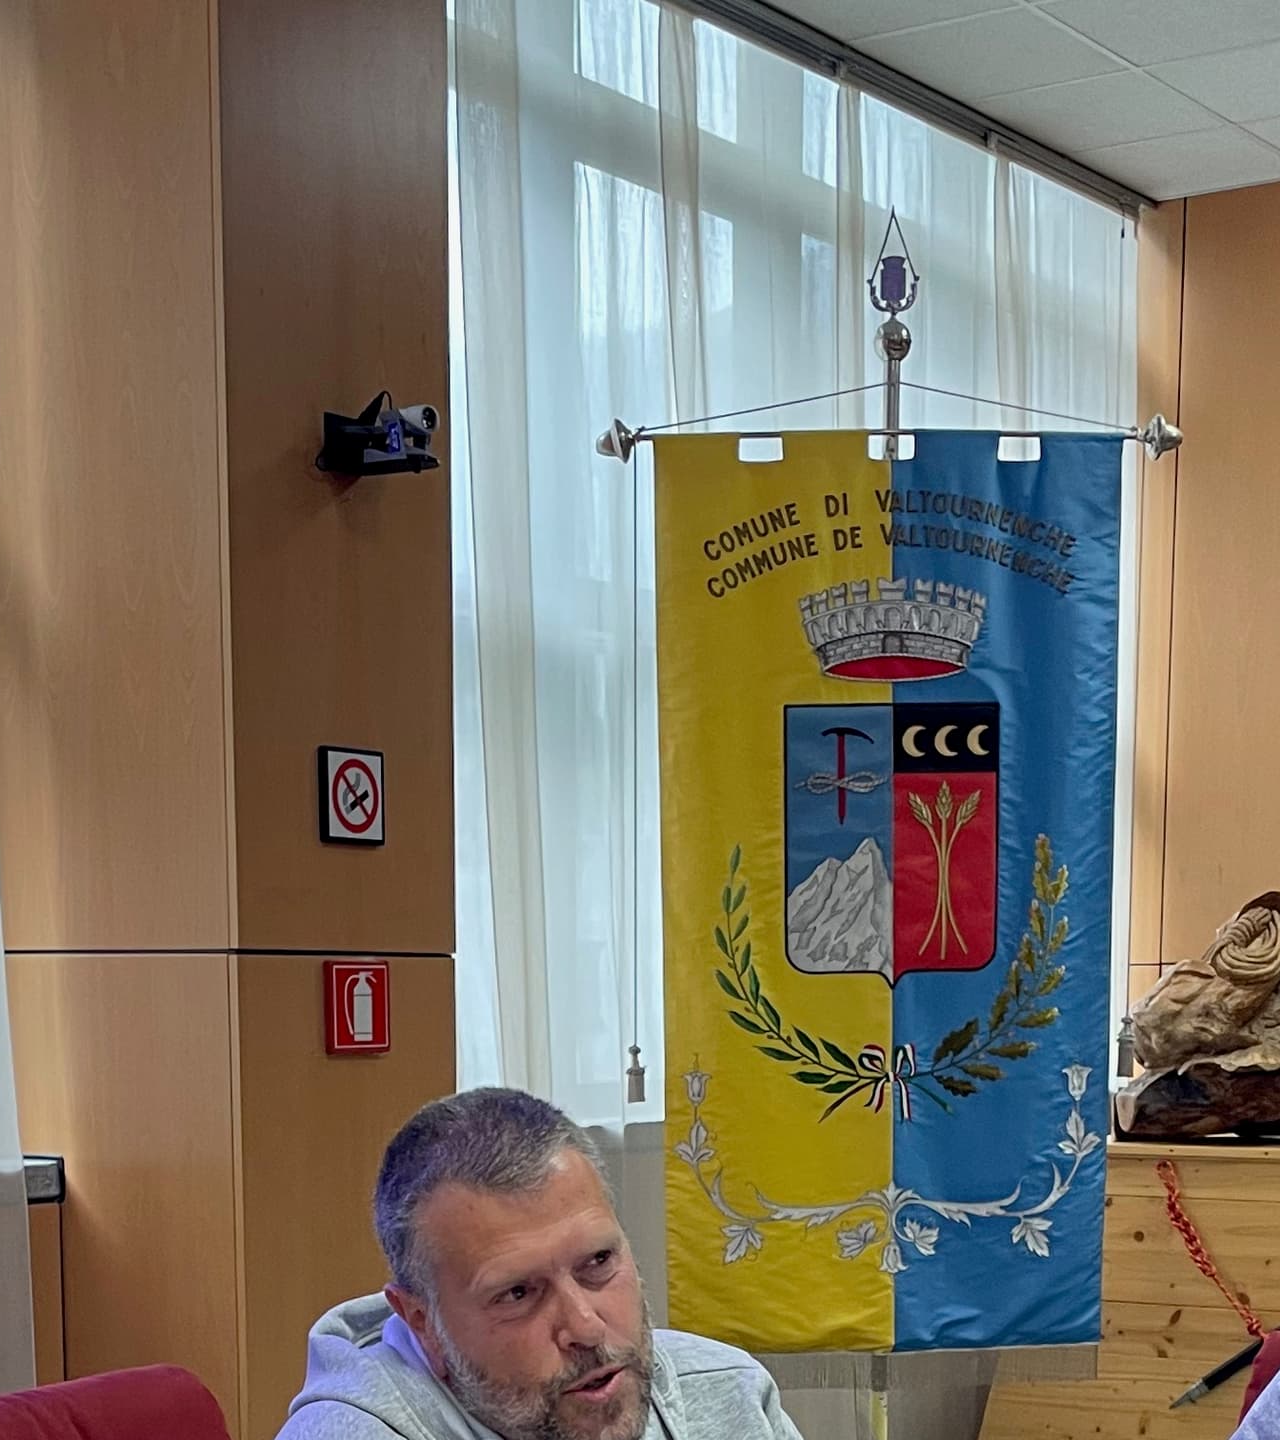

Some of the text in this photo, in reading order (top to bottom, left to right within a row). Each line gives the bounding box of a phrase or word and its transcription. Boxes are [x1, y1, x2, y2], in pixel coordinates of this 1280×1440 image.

[703, 488, 1078, 562] COMUNE DI VALTOURNENCHE
[706, 522, 1076, 599] COMMUNE DE VALTOURNENCHE
